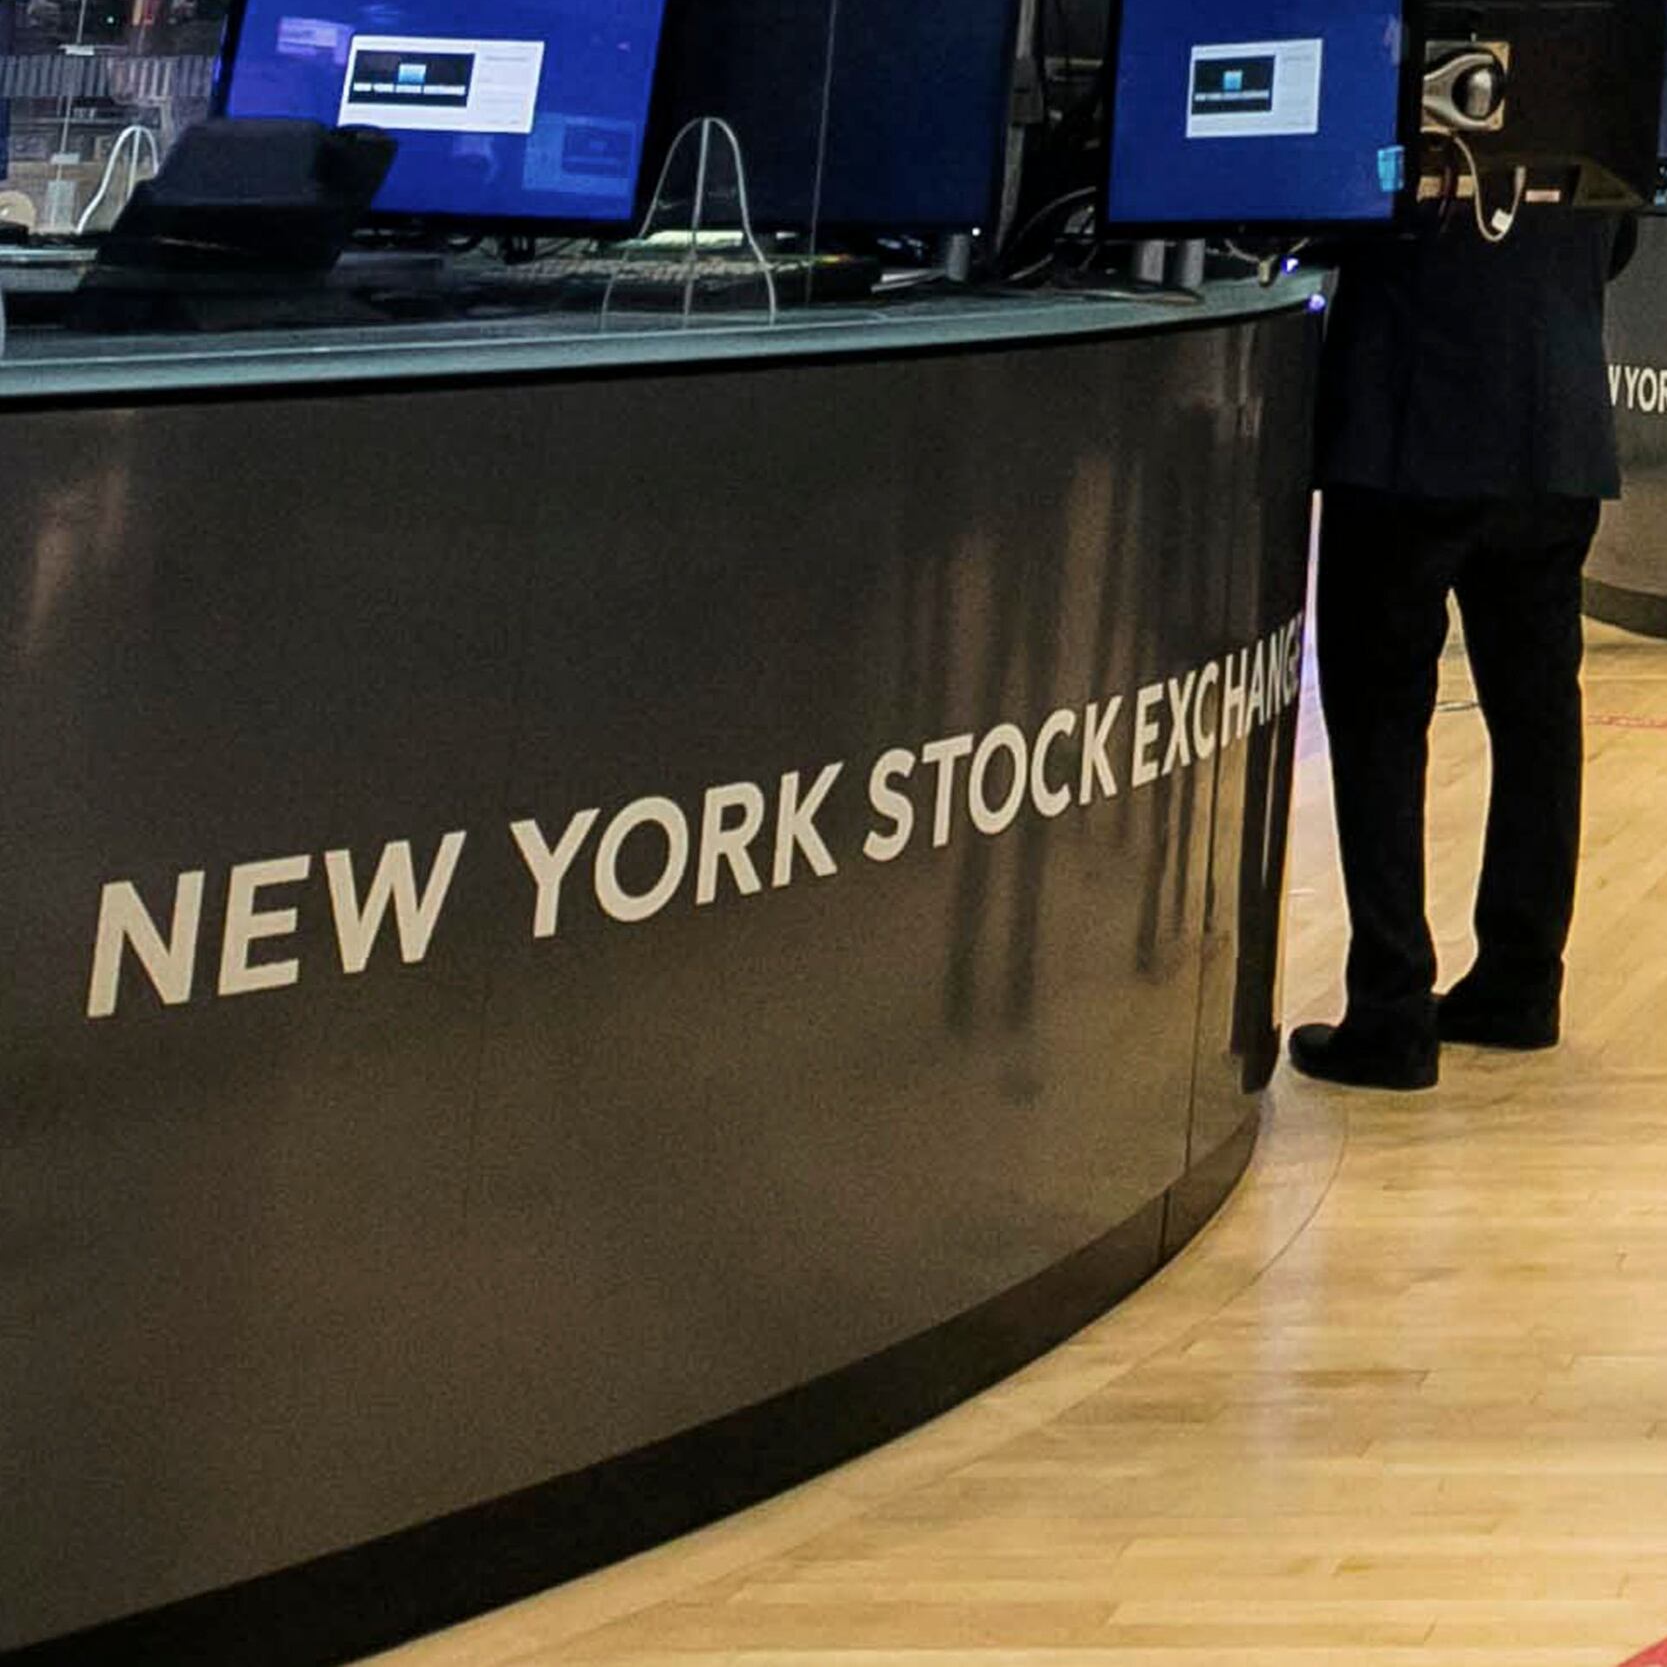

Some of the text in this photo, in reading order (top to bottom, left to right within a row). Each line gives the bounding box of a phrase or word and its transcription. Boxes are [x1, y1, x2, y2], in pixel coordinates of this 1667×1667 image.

[86, 830, 467, 1019] NEW
[510, 762, 844, 940] YORK
[860, 696, 1123, 864] STOCK
